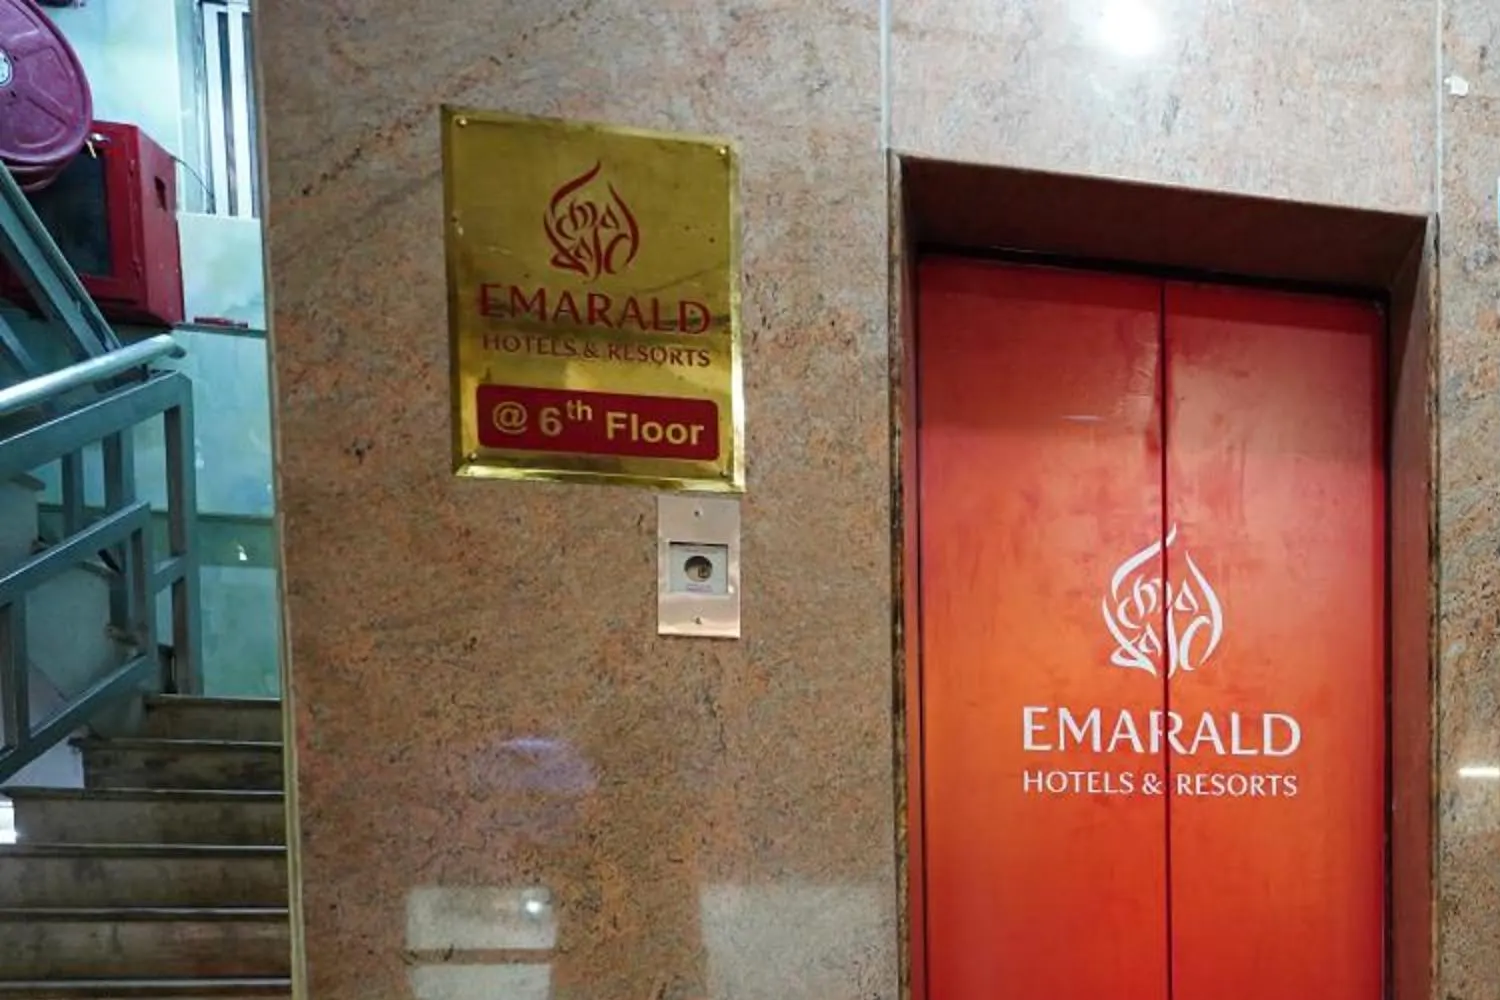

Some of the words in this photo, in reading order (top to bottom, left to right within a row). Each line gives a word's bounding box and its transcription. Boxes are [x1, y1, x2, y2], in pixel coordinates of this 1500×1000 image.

[479, 283, 711, 335] EMARALD
[483, 335, 577, 357] HOTELS
[583, 340, 599, 358] &
[608, 345, 710, 367] RESORTS
[492, 401, 528, 434] @
[606, 411, 704, 446] Floor
[1023, 706, 1301, 757] EMARALD
[1023, 770, 1134, 795] HOTELS
[1142, 773, 1164, 795] &
[1177, 773, 1298, 797] RESORTS
